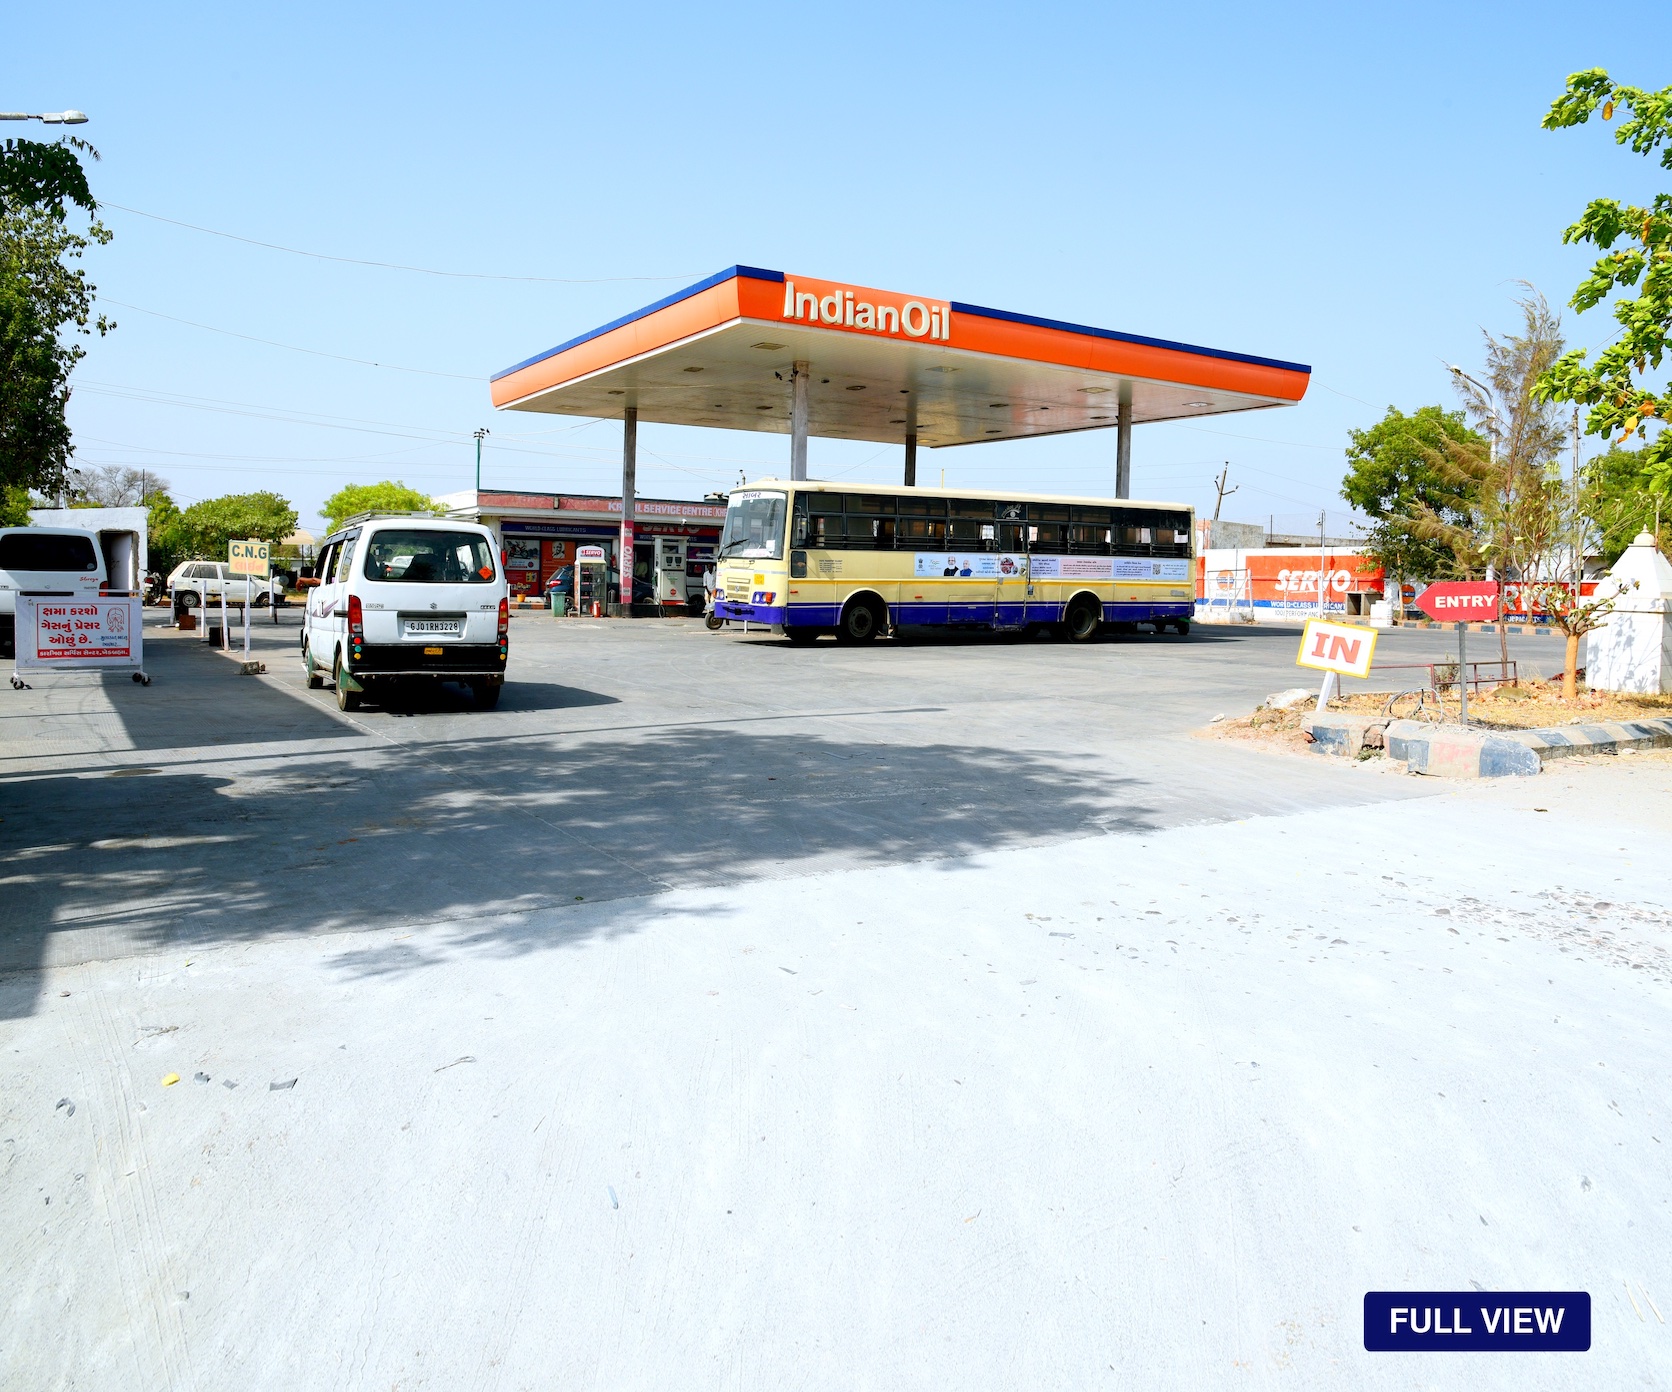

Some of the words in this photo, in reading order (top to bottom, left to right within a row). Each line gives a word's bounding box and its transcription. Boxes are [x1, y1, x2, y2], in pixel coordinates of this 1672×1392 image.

[783, 281, 950, 341] IndianOil
[644, 504, 681, 515] SERVICE
[682, 506, 712, 517] CENTRE
[231, 544, 267, 560] C.N.G
[623, 545, 633, 579] SERVO
[1274, 569, 1352, 592] SERVO
[1270, 601, 1311, 609] WORD-CLASS
[1434, 594, 1496, 609] ENTRY
[42, 607, 66, 617] ક્ષમા
[70, 604, 98, 616] કરશો
[41, 619, 72, 633] ગેસનું
[48, 633, 76, 647] ઓછું
[1311, 631, 1362, 665] IN
